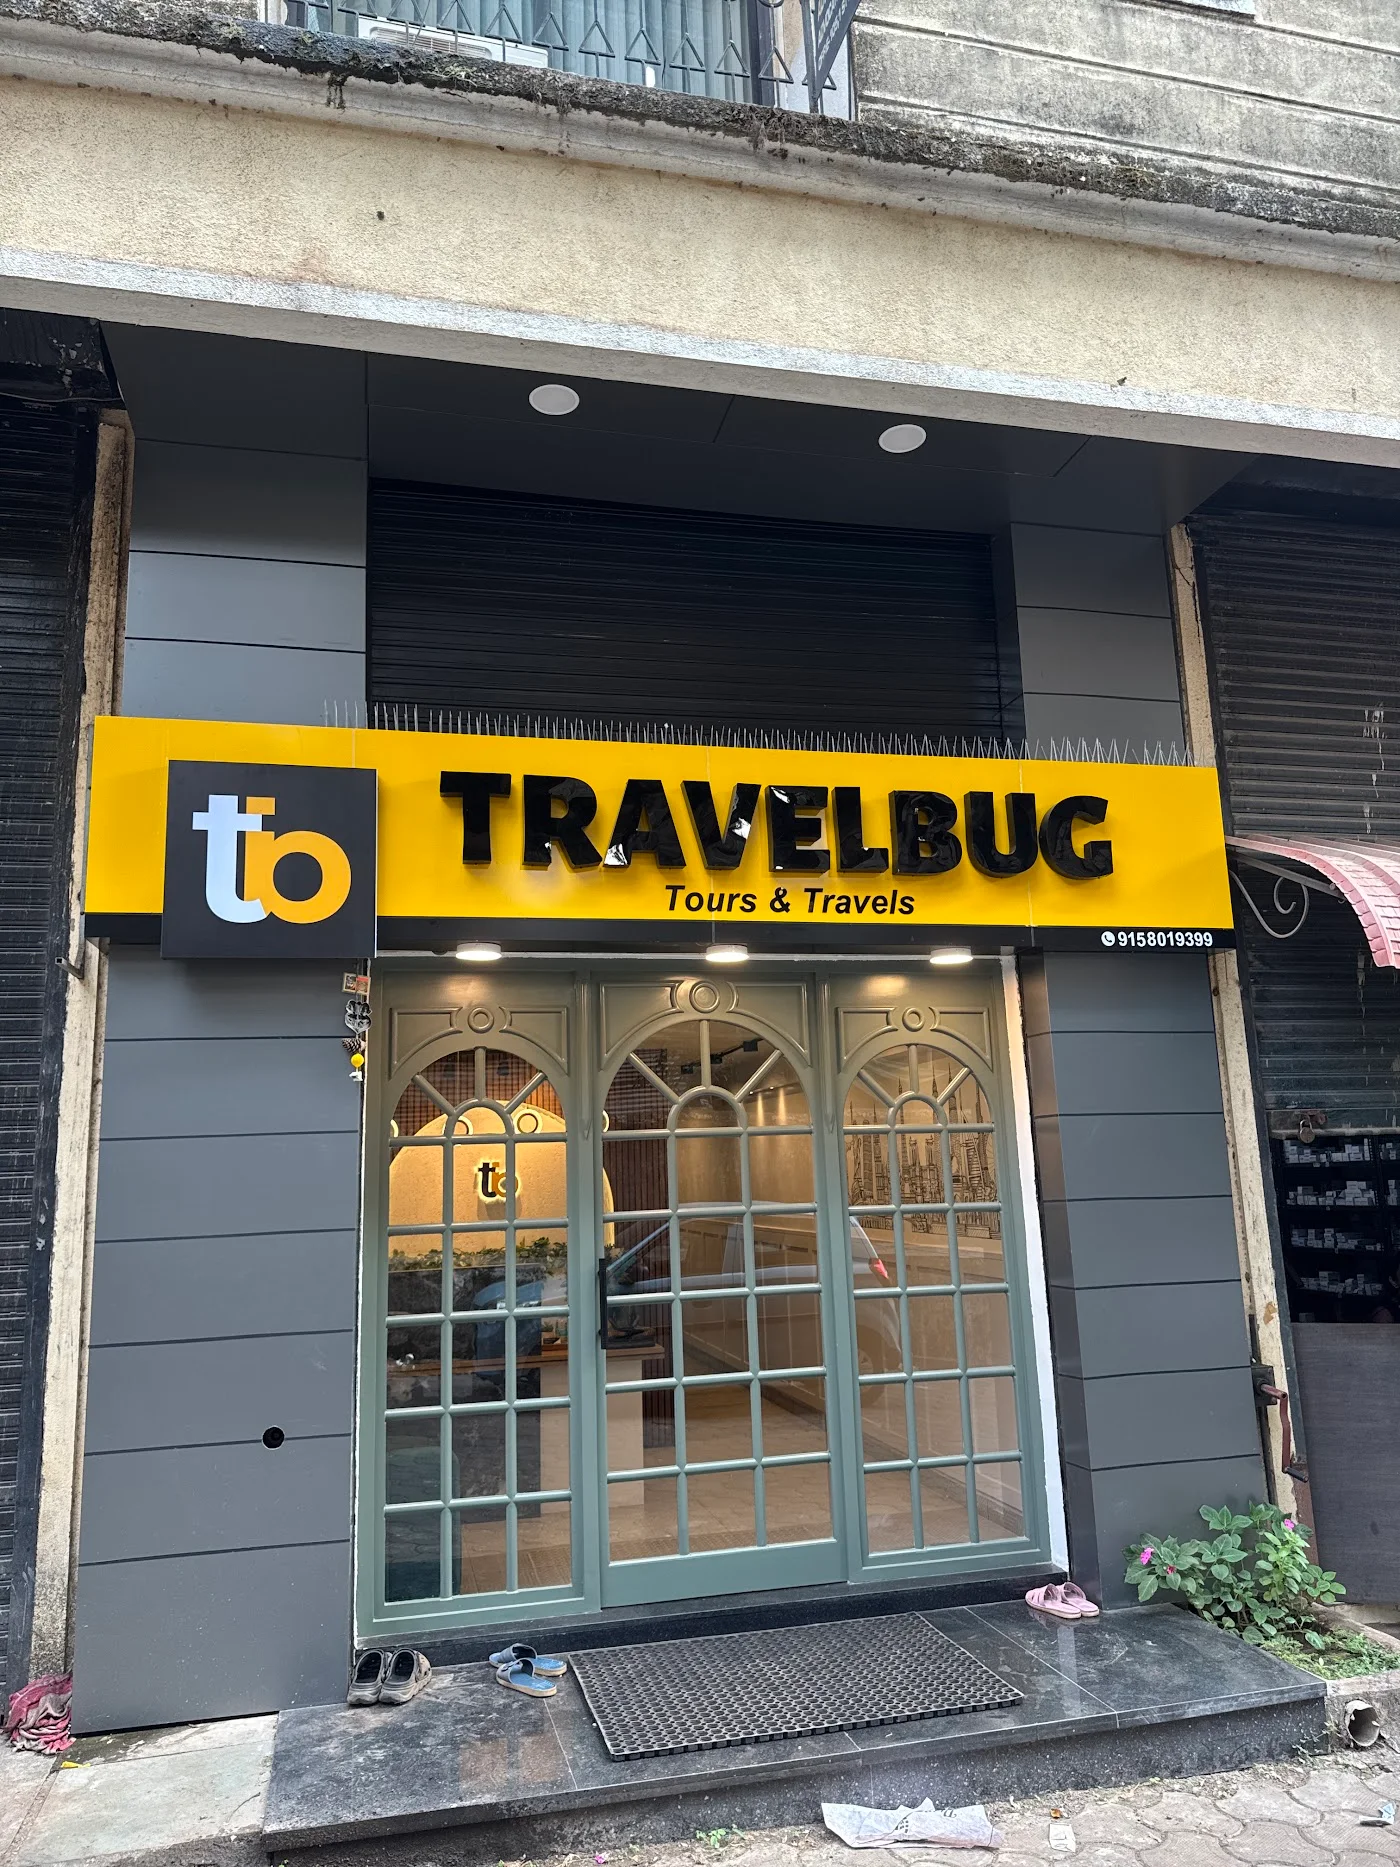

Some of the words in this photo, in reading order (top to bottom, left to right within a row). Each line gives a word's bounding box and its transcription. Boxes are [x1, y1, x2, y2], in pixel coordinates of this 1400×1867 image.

[440, 770, 1113, 879] TRAVELBUG
[665, 884, 757, 912] Tours
[769, 886, 791, 913] &
[803, 887, 915, 915] Travels
[1117, 931, 1213, 947] 9158019399
